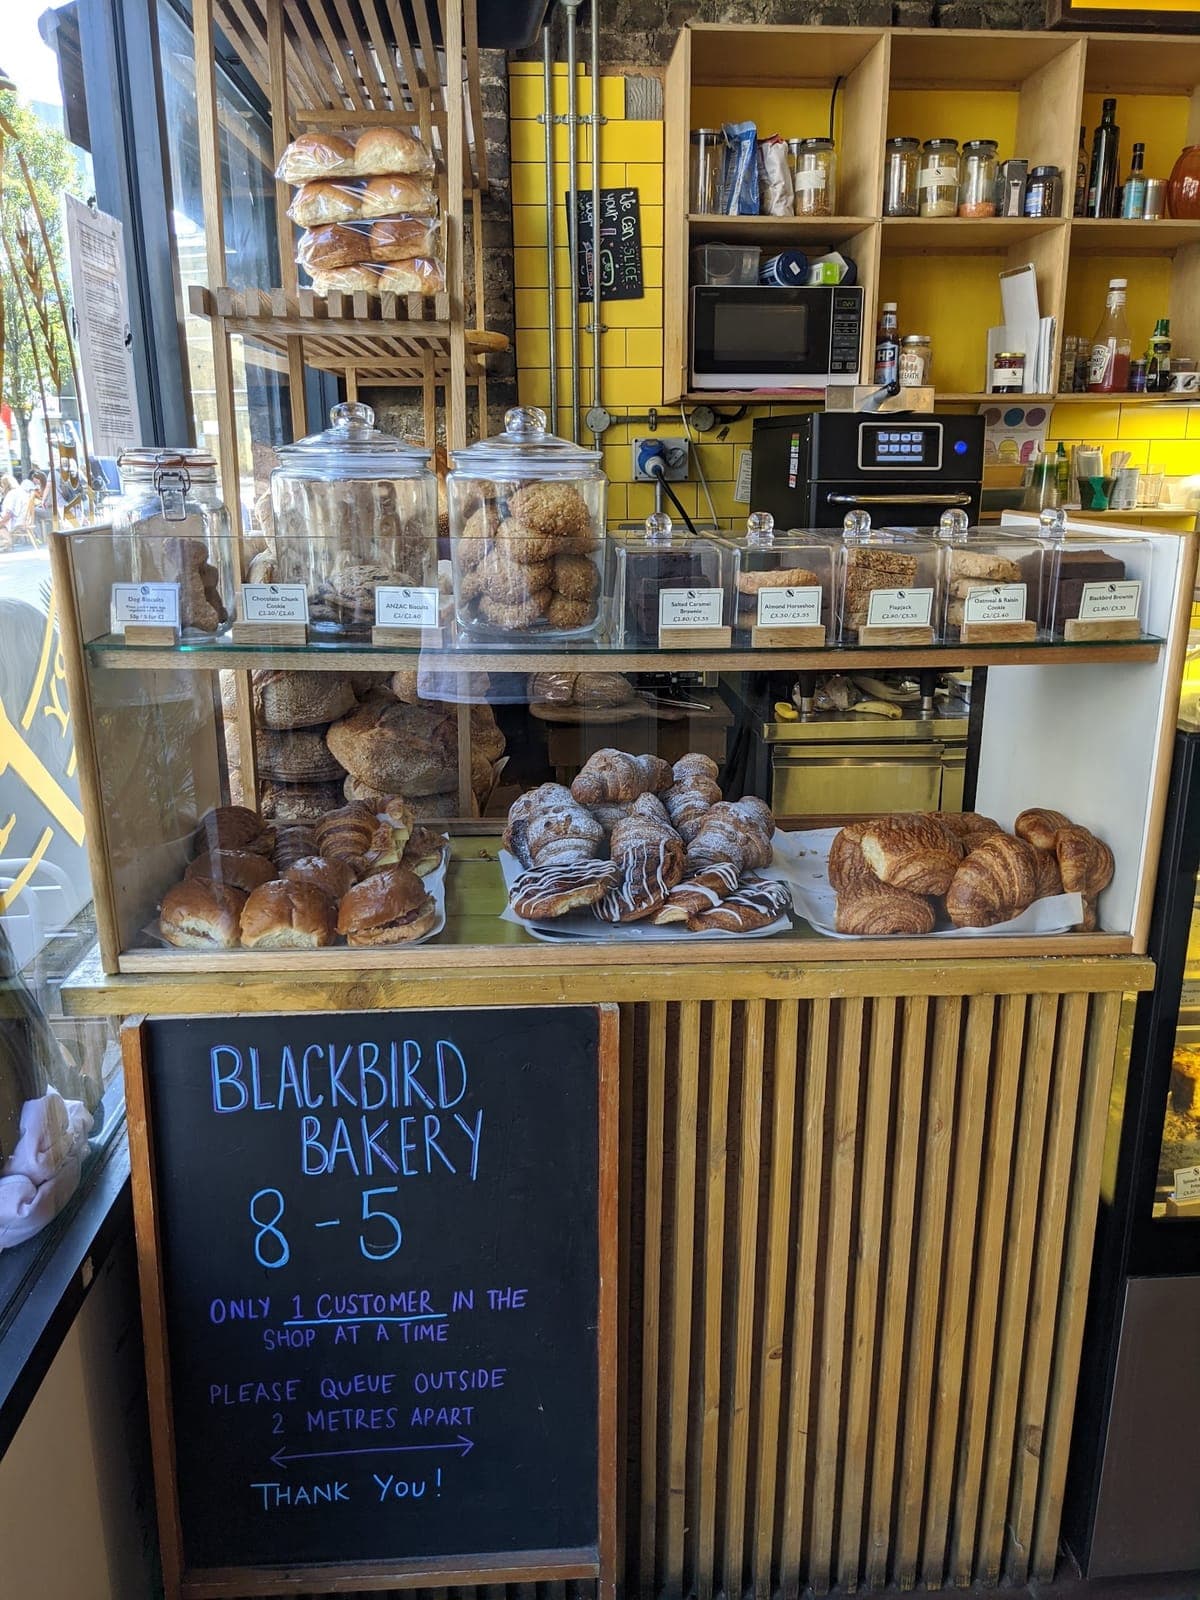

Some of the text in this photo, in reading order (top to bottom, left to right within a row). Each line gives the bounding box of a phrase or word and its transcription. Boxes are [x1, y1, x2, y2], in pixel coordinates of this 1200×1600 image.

[602, 193, 619, 222] your
[620, 191, 638, 282] We Can SLICE
[878, 350, 894, 360] HP
[211, 1040, 467, 1113] BLACKBIRD
[302, 1108, 483, 1181] BAKERY
[250, 1188, 290, 1268] 8
[360, 1186, 402, 1260] 5
[210, 1287, 528, 1324] ONLY 1 CUSTOMER IN THE
[264, 1322, 450, 1350] SHOP AT A TIME
[210, 1368, 507, 1404] PLEASE QUEUE OUTSIDE
[272, 1406, 475, 1434] 2 METRES APART
[250, 1482, 350, 1510] THANK
